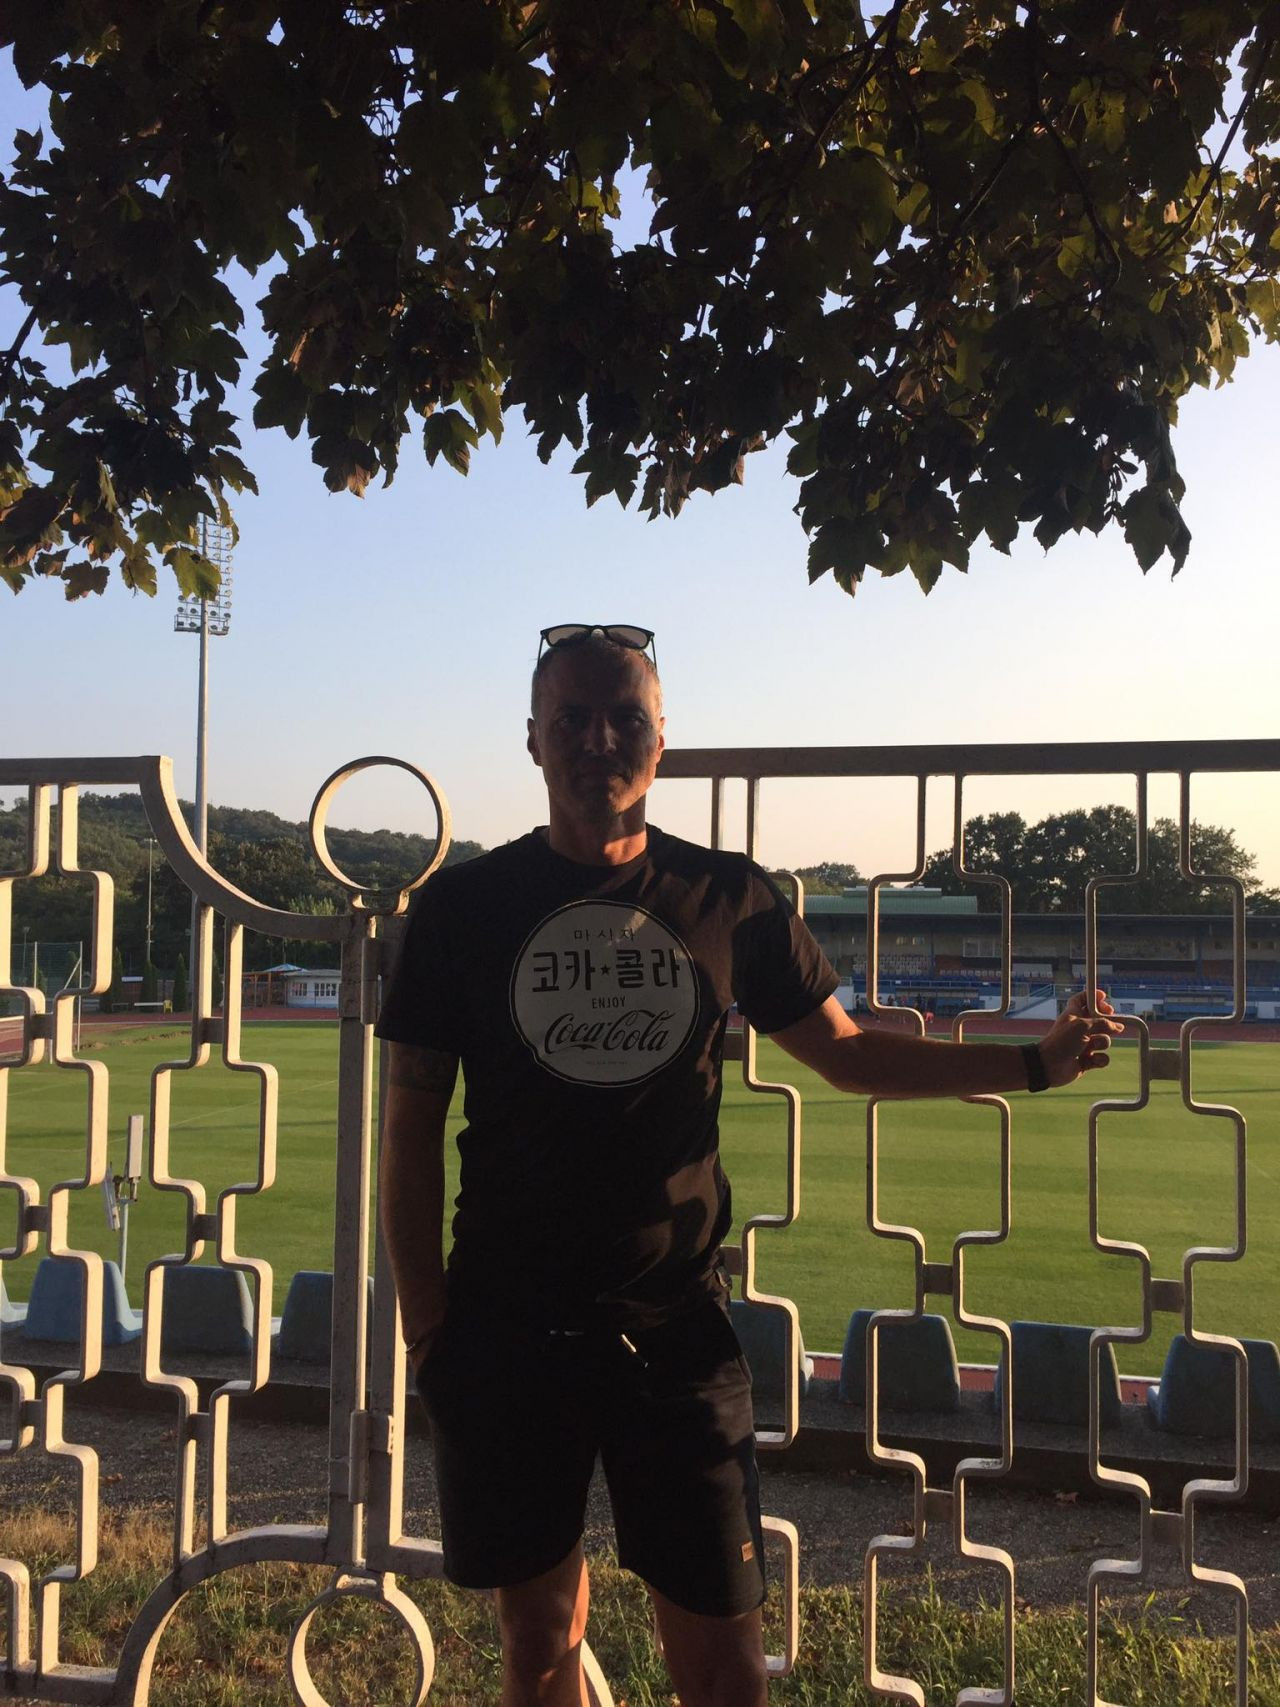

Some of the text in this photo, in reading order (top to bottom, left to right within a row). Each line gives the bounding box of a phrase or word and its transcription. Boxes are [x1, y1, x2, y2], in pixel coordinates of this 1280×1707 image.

[574, 928, 635, 941] 마시자
[592, 996, 625, 1009] ENJOY
[545, 1010, 675, 1054] Coca-Cola
